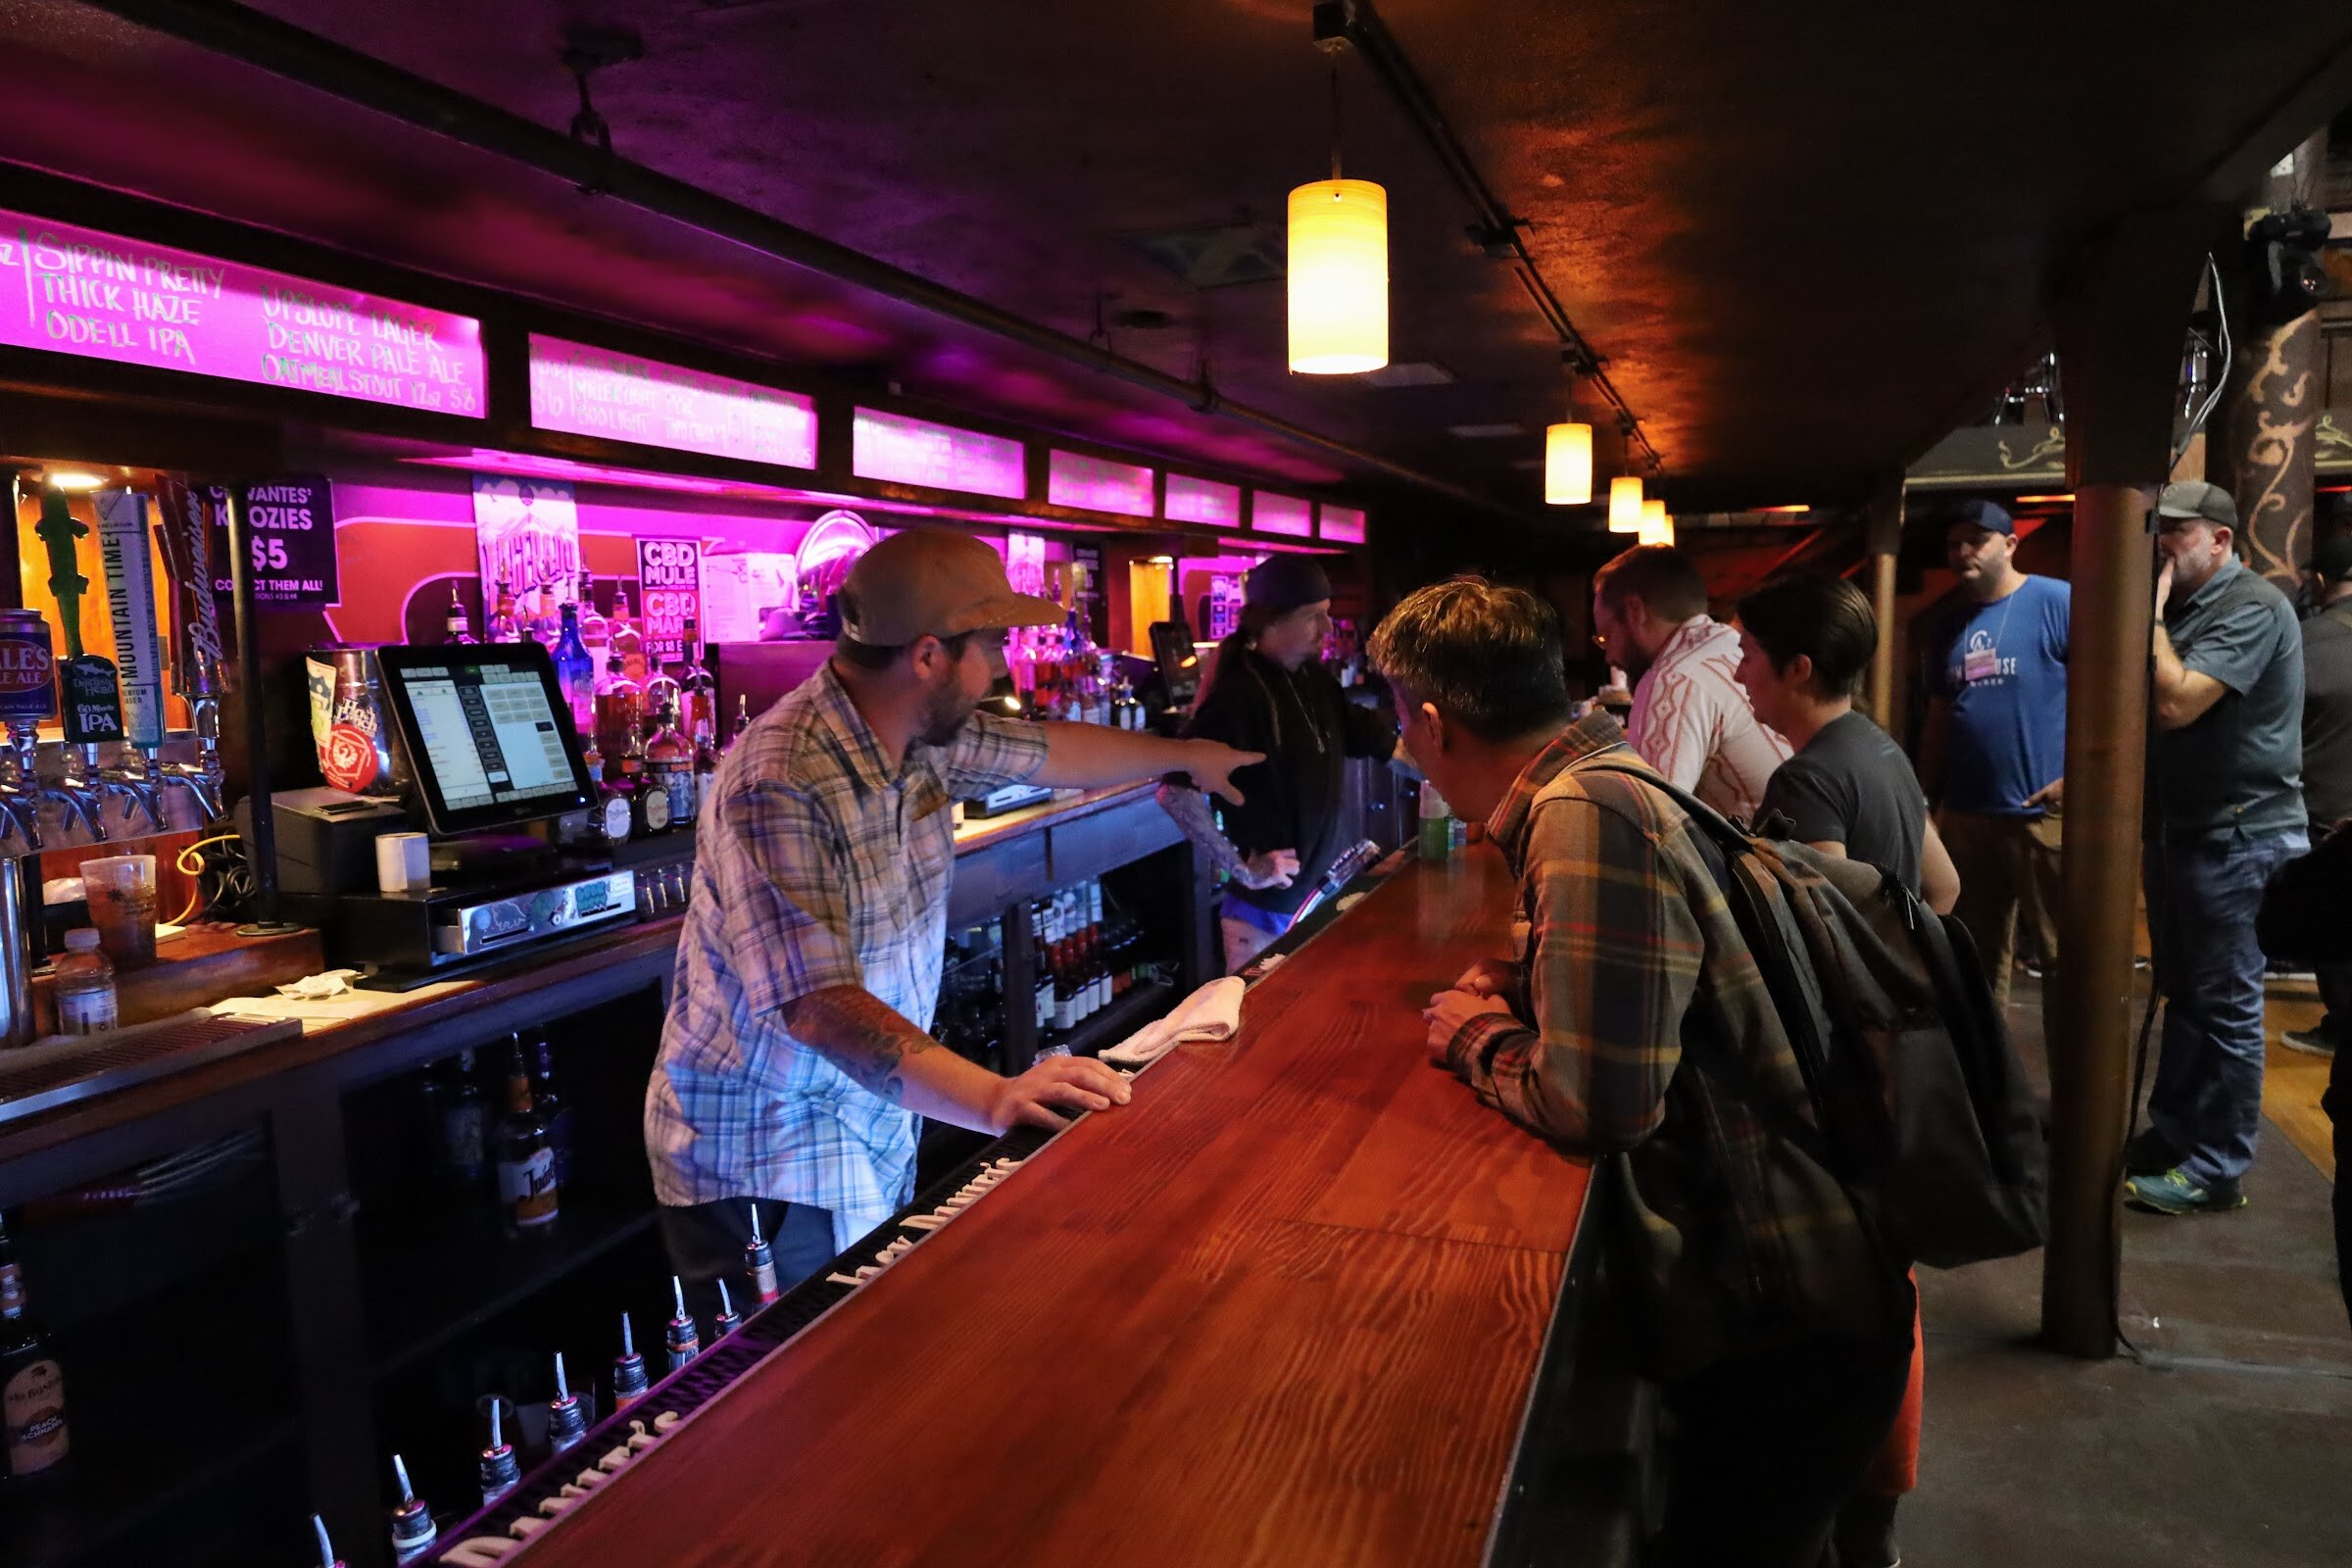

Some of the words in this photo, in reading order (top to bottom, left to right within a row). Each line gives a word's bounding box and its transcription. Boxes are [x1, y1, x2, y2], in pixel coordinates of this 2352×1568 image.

[34, 232, 137, 282] SIPPIN
[143, 256, 225, 299] PRETTY
[34, 272, 124, 312] THICK
[132, 288, 203, 325] HAZE
[261, 284, 361, 335] UPSLOPE
[371, 309, 444, 353] LAGER
[46, 310, 138, 347] ODELL
[149, 326, 196, 365] IPA
[266, 320, 366, 367] DENVER
[371, 343, 422, 375] PALE
[429, 354, 466, 386] ALE
[261, 352, 348, 392] OATMEAL
[348, 369, 403, 399] STOUT
[214, 504, 314, 530] KOZIES
[102, 538, 124, 581] TIME
[251, 535, 288, 572] $5
[644, 542, 695, 567] CBD
[182, 491, 223, 667] Budweiser
[269, 579, 299, 591] THEM
[302, 579, 323, 592] ALL!
[645, 565, 696, 585] MULE
[646, 592, 697, 617] CBD
[108, 588, 138, 678] MOUNTAIN
[647, 616, 684, 634] MAR
[17, 671, 43, 684] ALE
[78, 712, 118, 733] IPA
